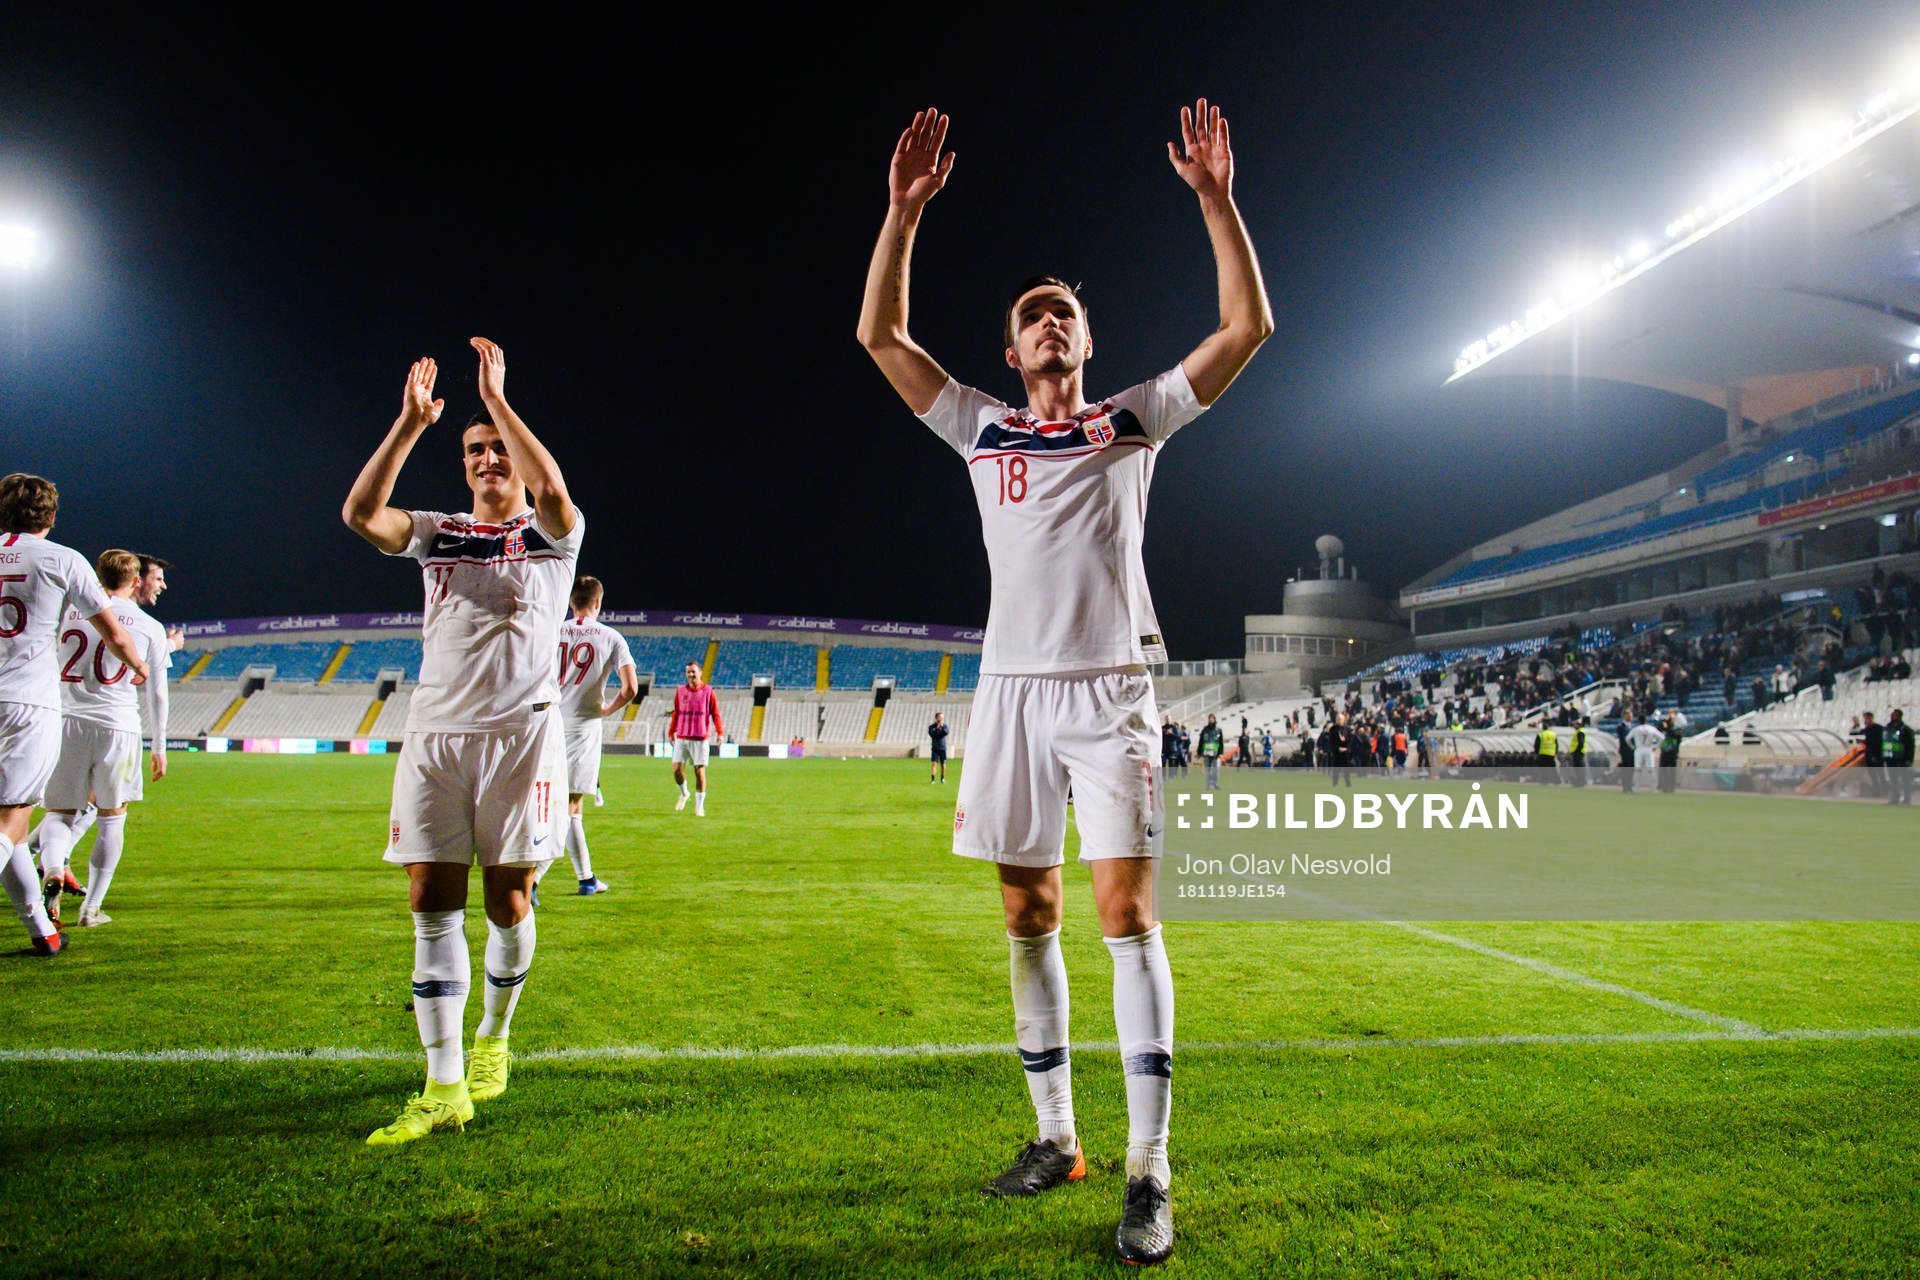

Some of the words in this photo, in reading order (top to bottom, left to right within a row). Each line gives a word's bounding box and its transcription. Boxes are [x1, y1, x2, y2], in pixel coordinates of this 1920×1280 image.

[996, 455, 1028, 506] 18
[431, 566, 456, 605] 11
[268, 614, 341, 631] cablenet
[677, 613, 743, 626] cablenet
[777, 616, 837, 631] cablenet
[870, 622, 930, 637] cablenet
[61, 628, 128, 685] 20
[559, 641, 595, 686] 19
[536, 781, 551, 823] 11
